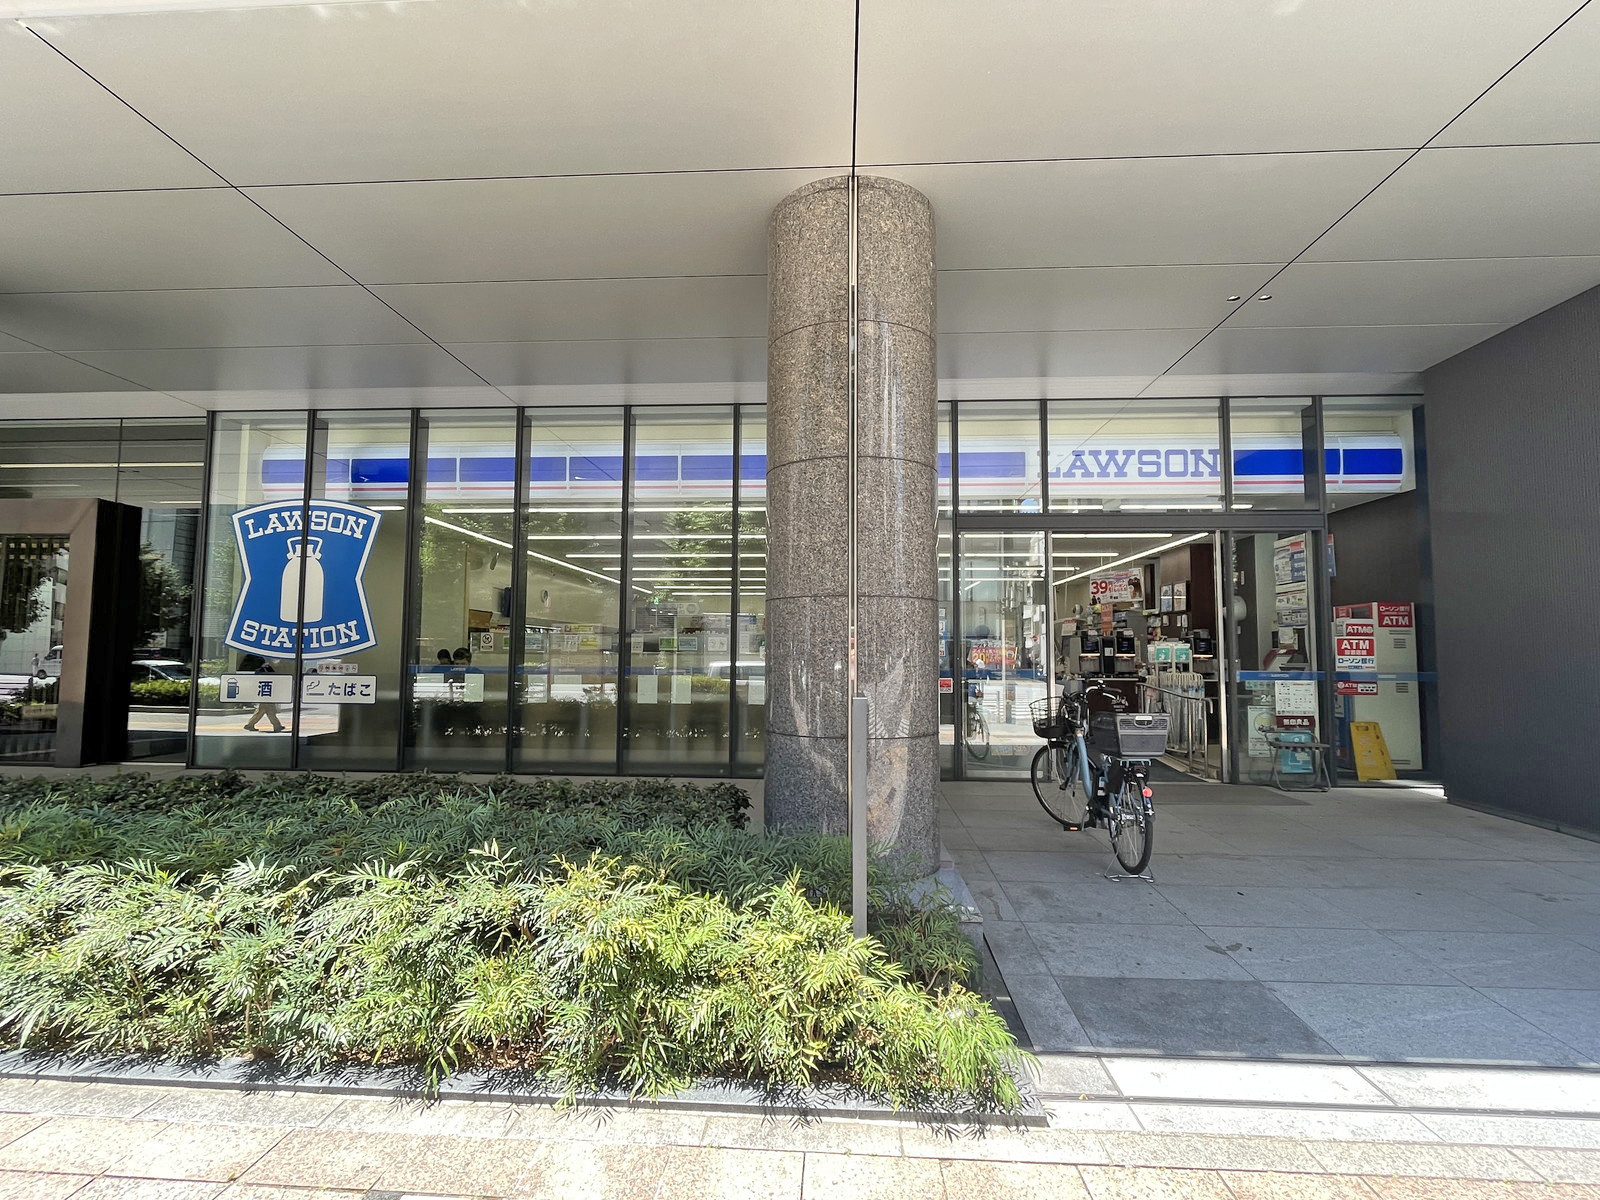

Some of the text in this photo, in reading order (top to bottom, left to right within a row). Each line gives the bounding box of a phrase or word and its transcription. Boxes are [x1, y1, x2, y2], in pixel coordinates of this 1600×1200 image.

[1037, 449, 1221, 478] LAWSON
[244, 510, 368, 540] LAWSON
[1090, 580, 1108, 595] 39
[1382, 615, 1409, 625] ATM
[240, 620, 360, 648] STATION
[1340, 640, 1370, 650] ATM
[257, 680, 274, 698] 酒
[327, 682, 371, 697] たばこ
